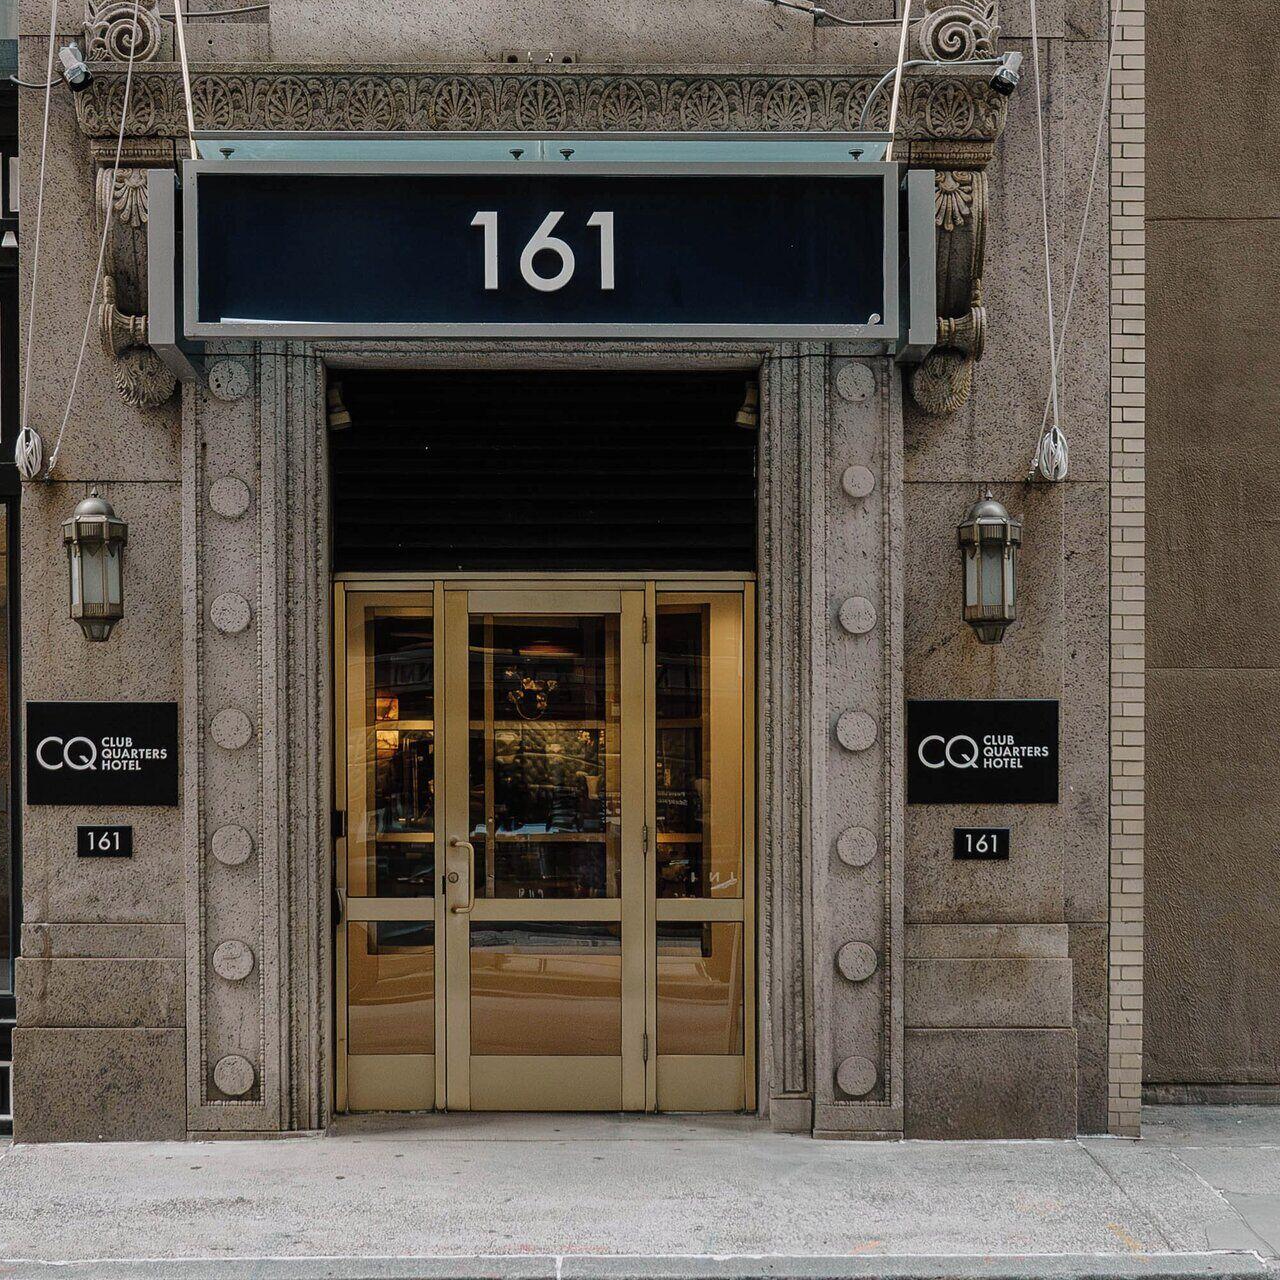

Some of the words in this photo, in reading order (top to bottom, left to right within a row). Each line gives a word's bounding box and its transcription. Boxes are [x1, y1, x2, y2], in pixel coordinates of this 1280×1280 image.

[470, 210, 615, 292] 161
[101, 737, 133, 748] CLUB
[983, 735, 1015, 746] CLUB
[36, 736, 97, 770] CQ
[101, 748, 168, 760] QUARTERS
[918, 734, 979, 769] CQ
[983, 746, 1049, 758] QUARTERS
[101, 760, 142, 771] HOTEL
[983, 758, 1023, 769] HOTEL
[87, 831, 120, 851] 161
[965, 834, 997, 853] 161
